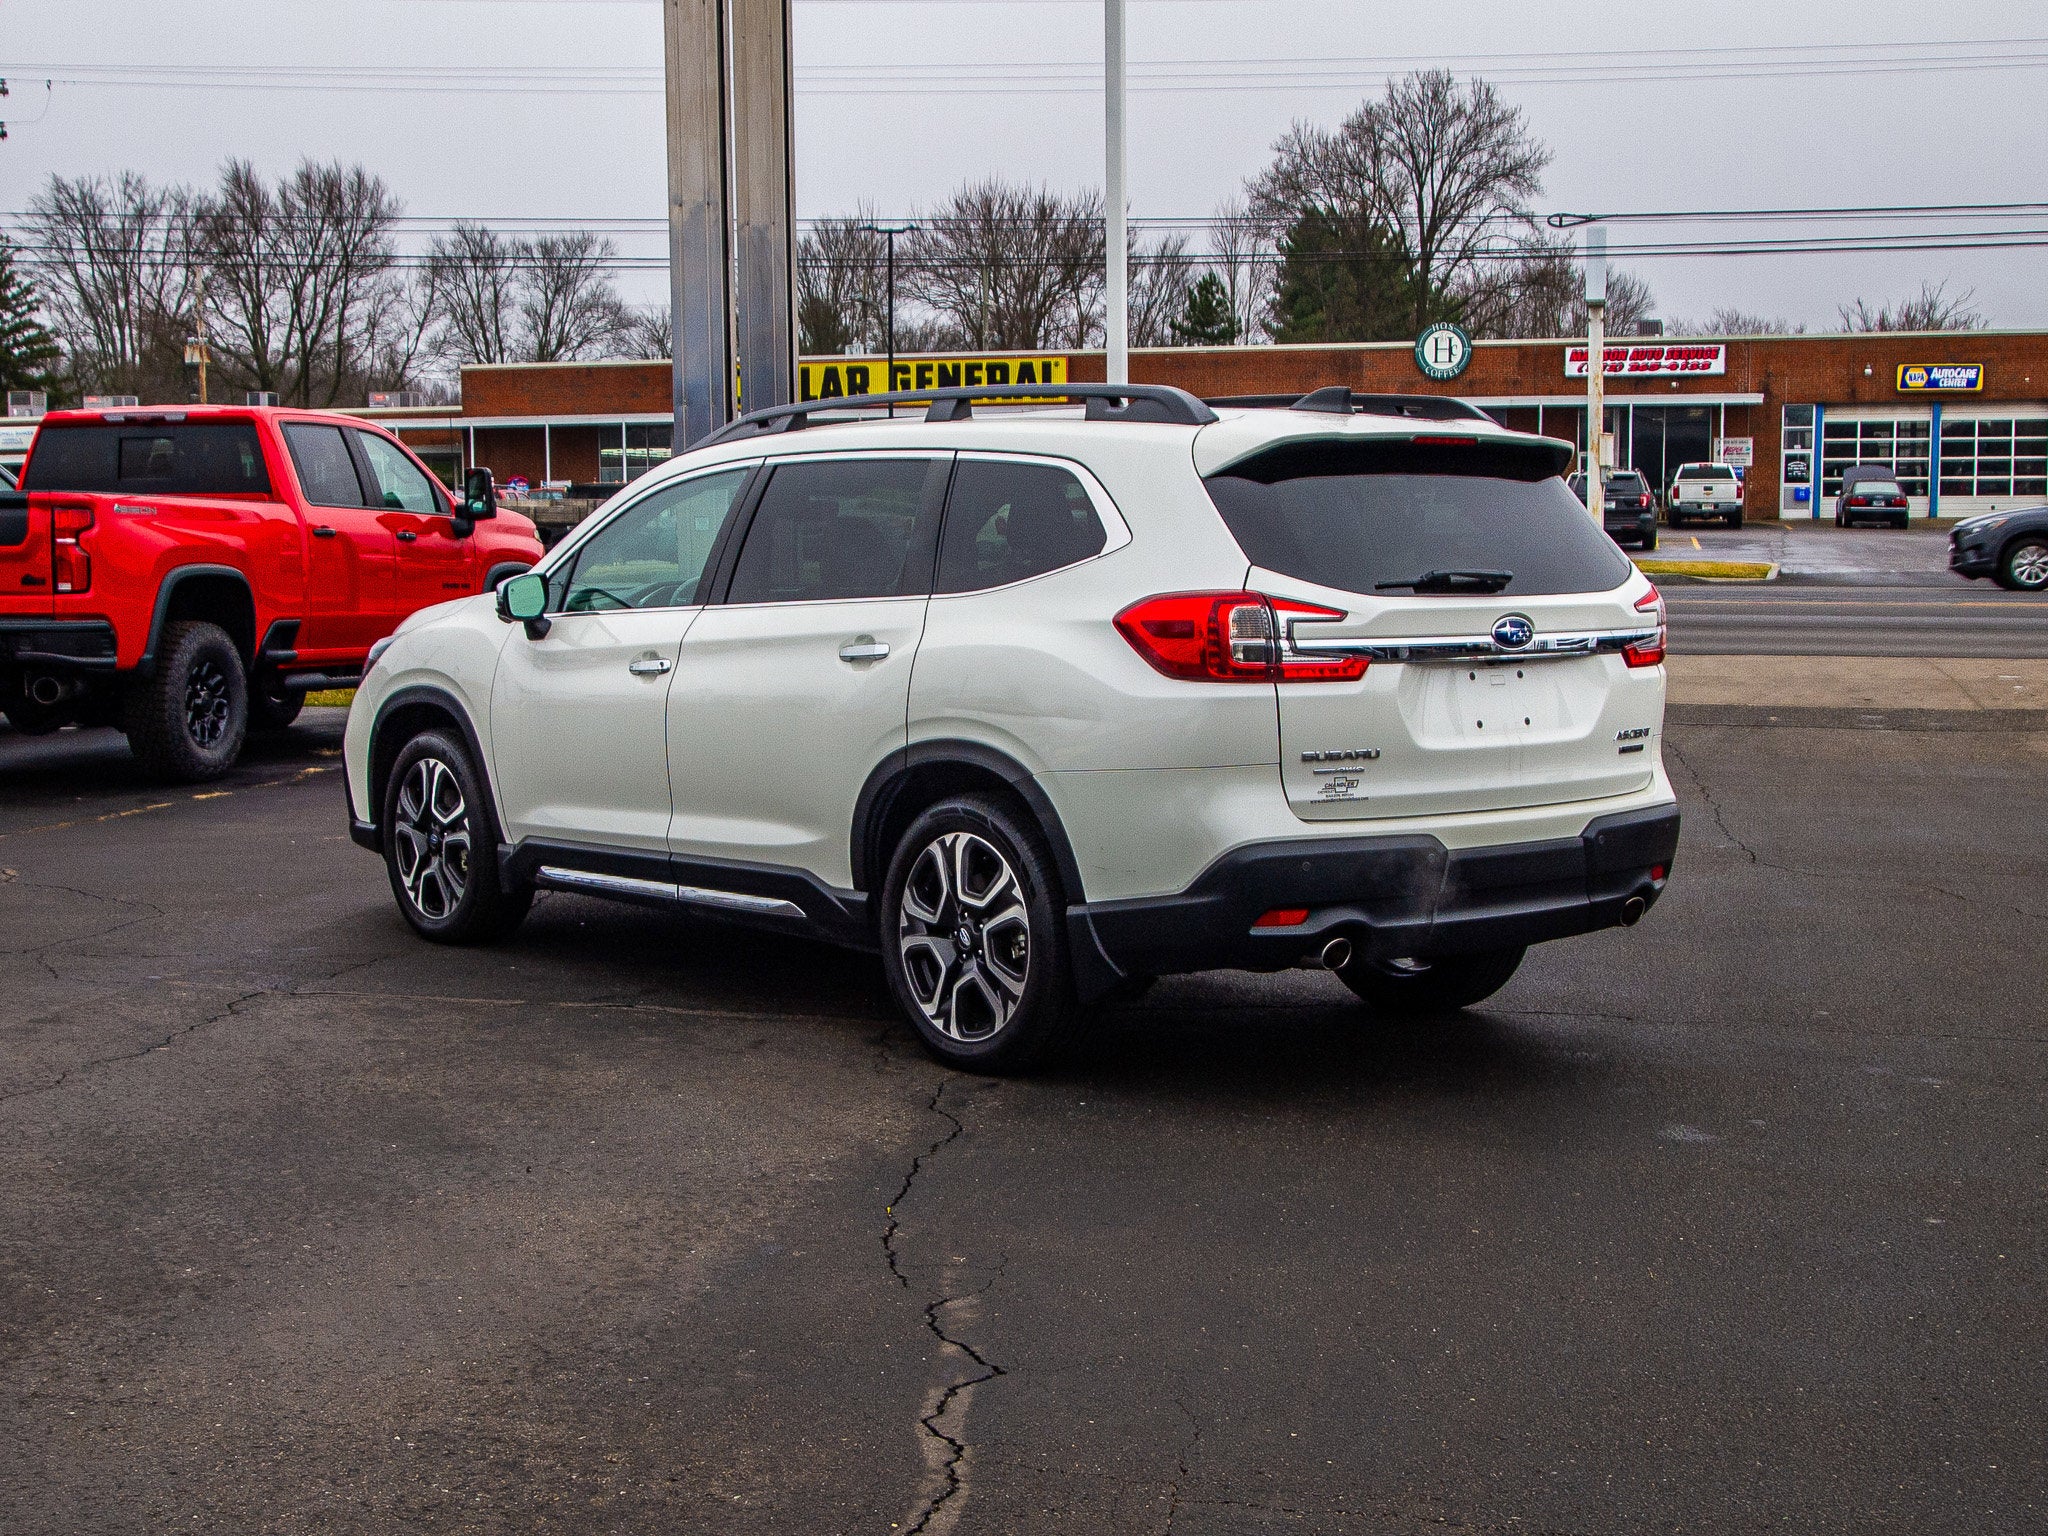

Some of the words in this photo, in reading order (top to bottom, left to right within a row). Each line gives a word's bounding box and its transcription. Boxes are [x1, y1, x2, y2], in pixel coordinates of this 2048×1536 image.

[1432, 322, 1454, 331] HOS
[1569, 348, 1628, 362] MASON
[1629, 348, 1665, 361] AUTO
[1665, 346, 1720, 361] SERVICE
[1425, 366, 1460, 378] COFFEE
[1908, 372, 1925, 382] NAPA
[800, 366, 870, 402] LAR
[891, 361, 1060, 398] GENERAL
[1940, 379, 1967, 387] CENTER
[1301, 747, 1381, 762] SUBARU
